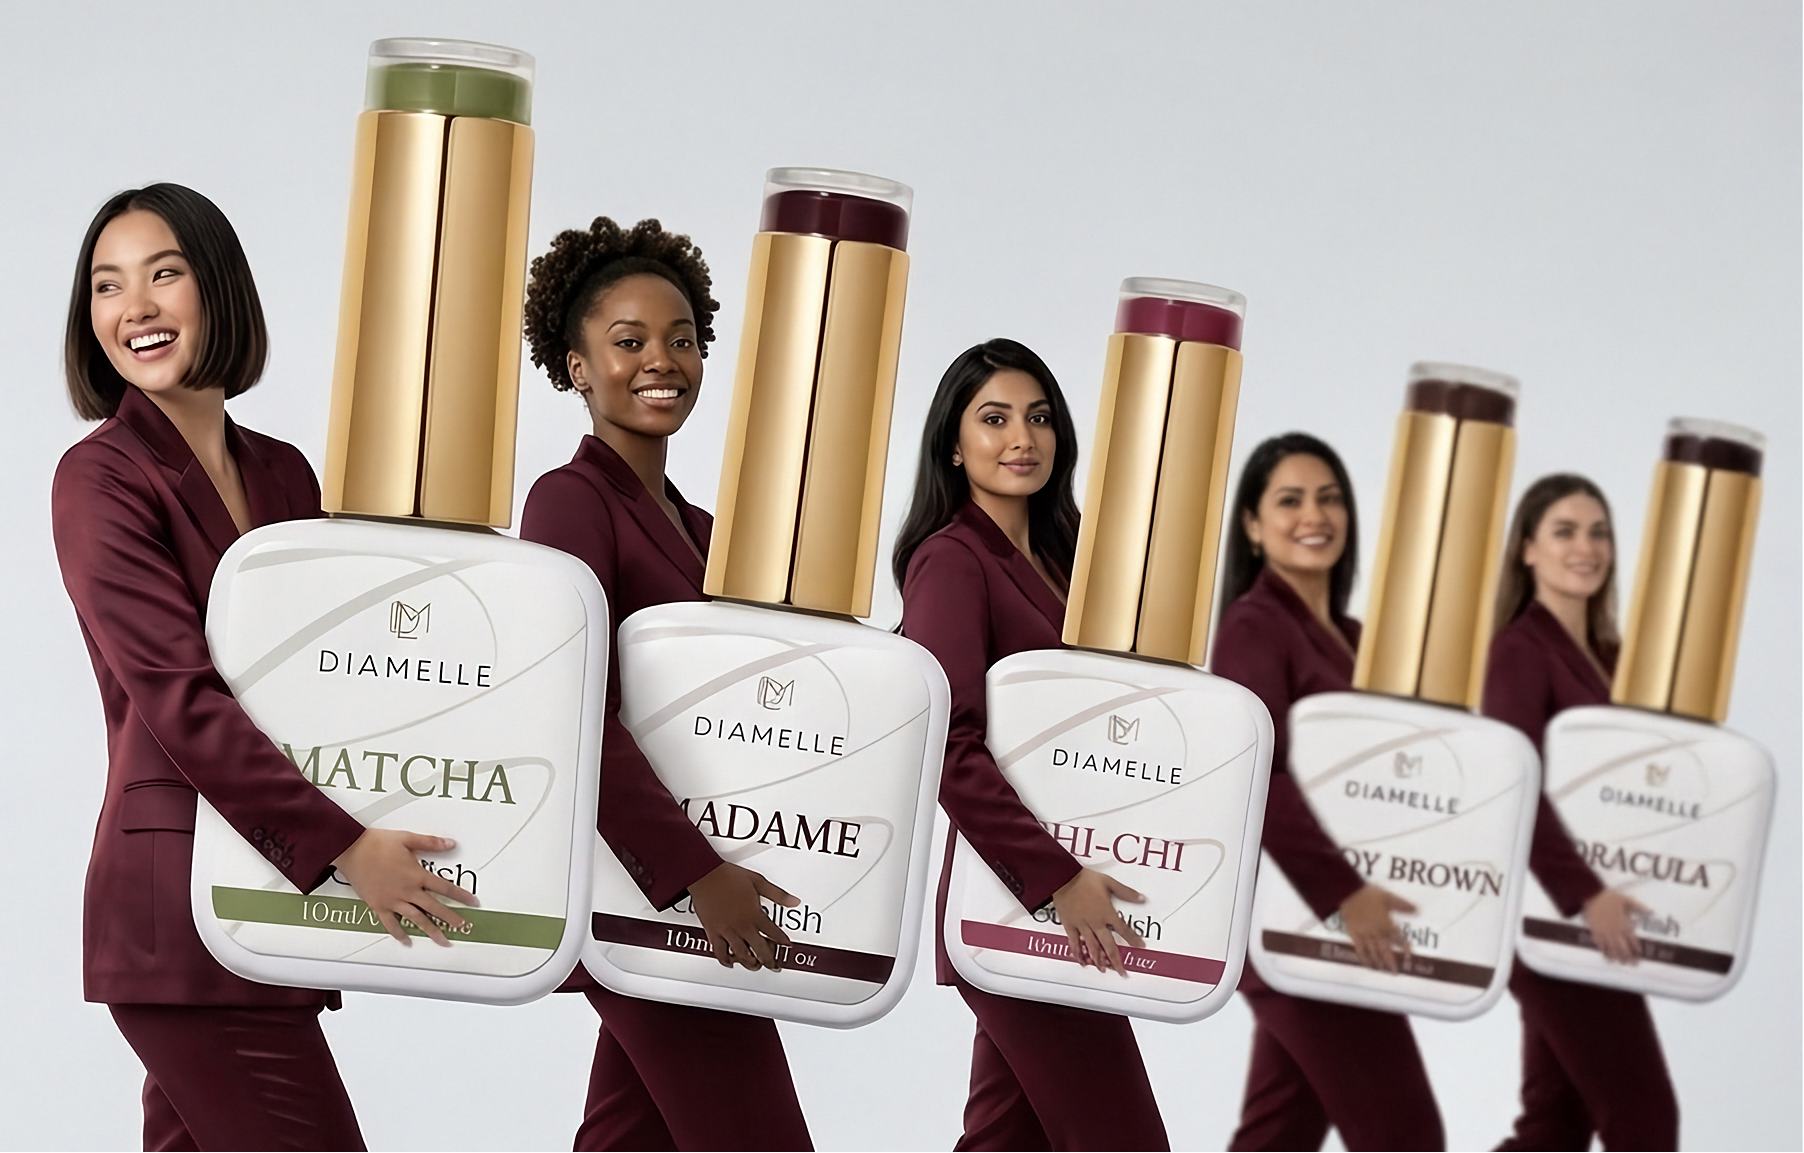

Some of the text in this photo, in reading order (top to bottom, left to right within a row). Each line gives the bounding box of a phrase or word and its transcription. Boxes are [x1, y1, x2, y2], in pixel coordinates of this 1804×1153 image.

[319, 650, 491, 687] DIAMELLE
[693, 716, 845, 756] DIAMELLE
[1053, 748, 1182, 785] DIAMELLE
[1344, 780, 1461, 815] DIAMELLE
[1599, 786, 1702, 820] DIAMELLE
[1040, 820, 1185, 872] HI-CHI
[1388, 855, 1504, 897] BROWN
